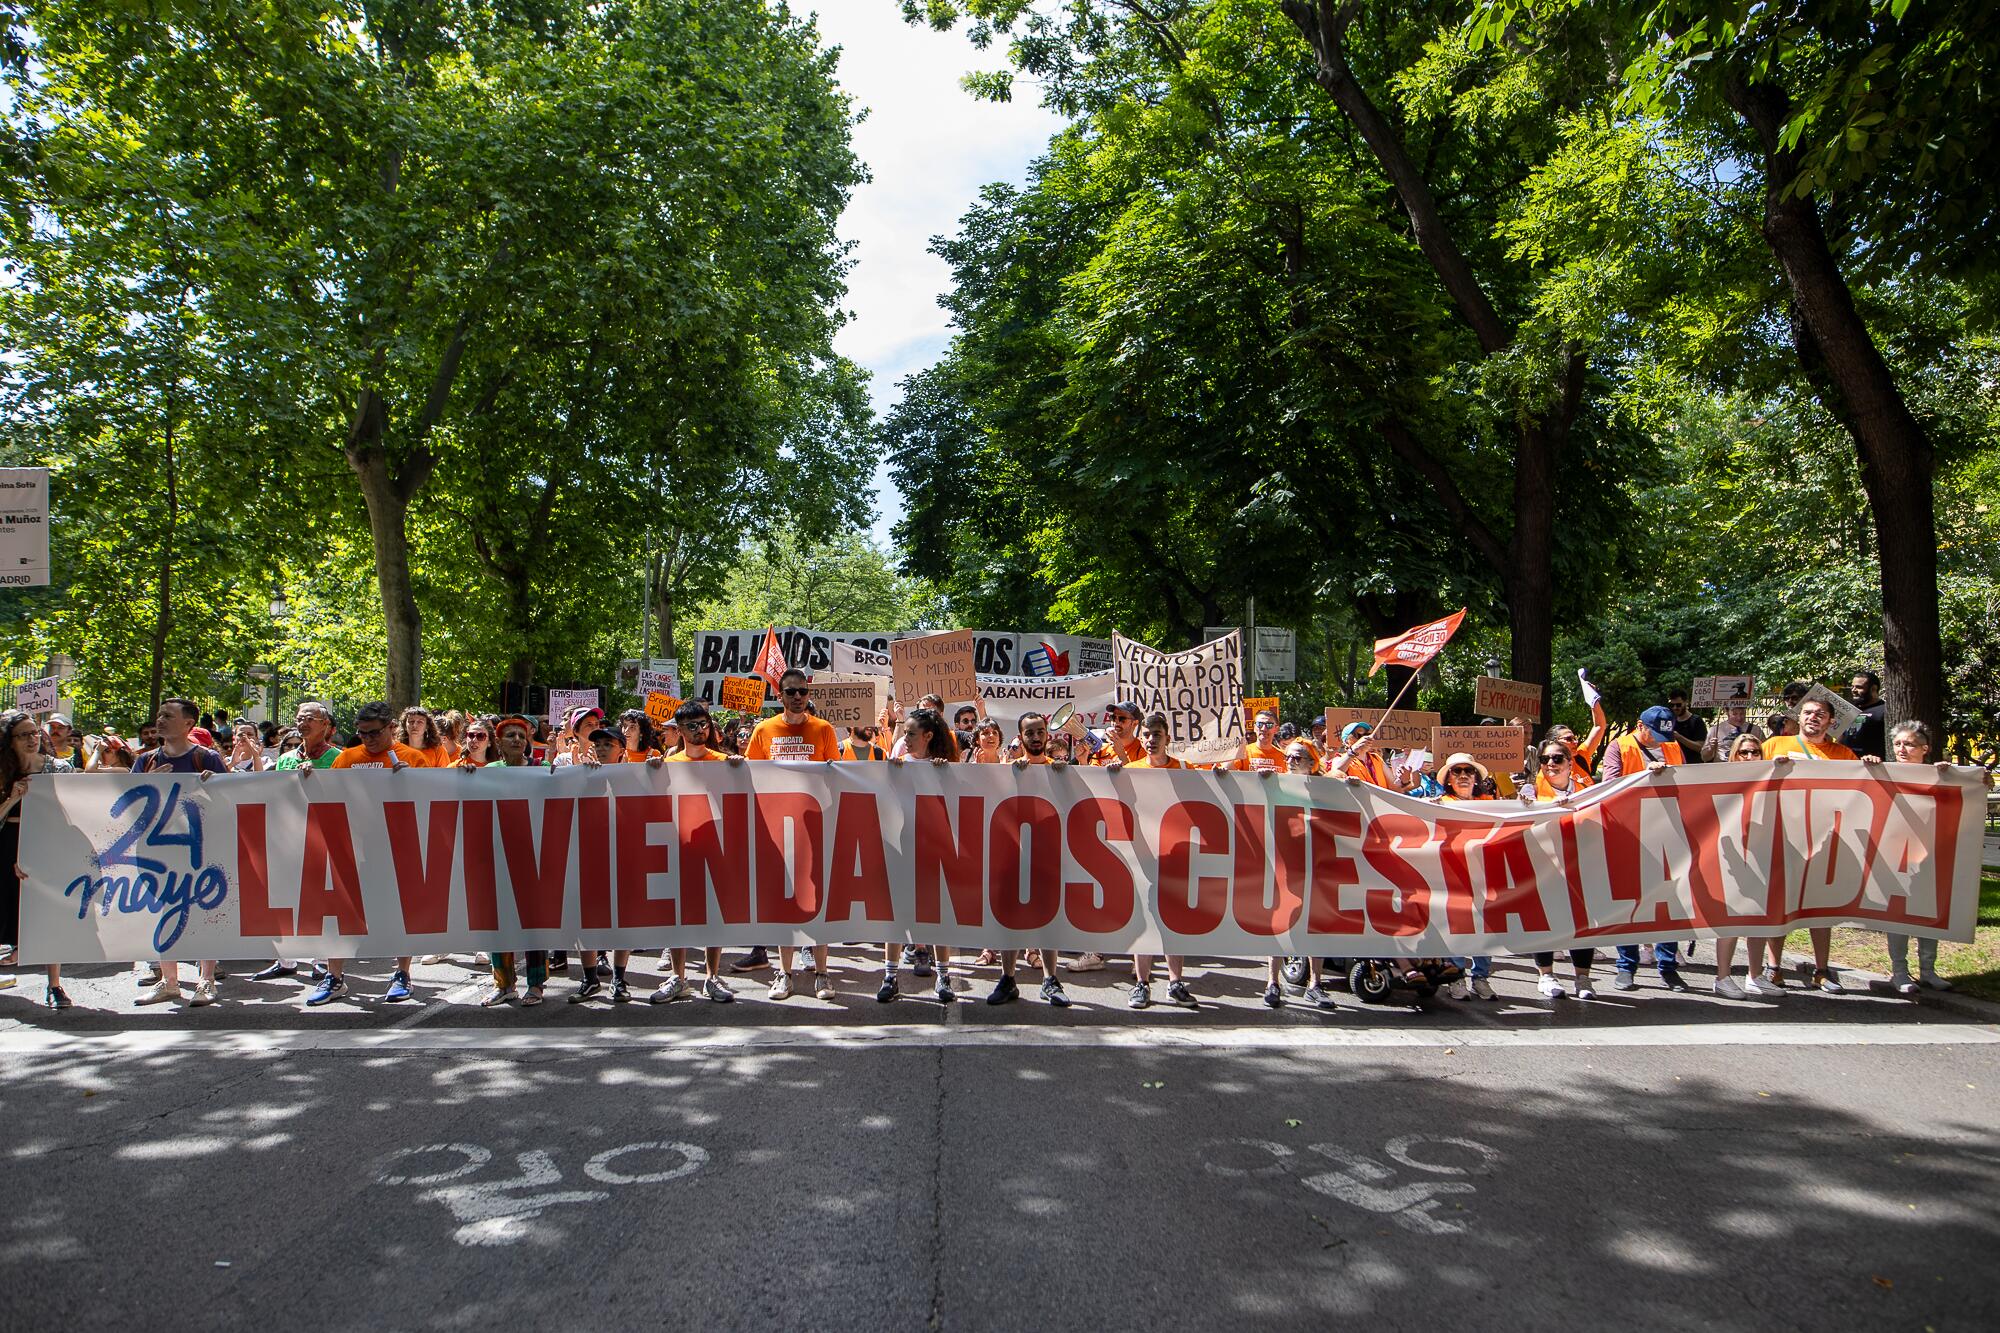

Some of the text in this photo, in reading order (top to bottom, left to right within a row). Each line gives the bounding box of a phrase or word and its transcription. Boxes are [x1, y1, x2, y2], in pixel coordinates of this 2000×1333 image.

[6, 515, 40, 524] Muñoz
[1213, 636, 1239, 662] EN
[908, 659, 965, 676] Y MENOS
[653, 673, 673, 682] CASAS
[19, 679, 53, 694] DERECHO
[828, 687, 873, 699] RENTISTAS
[33, 691, 40, 699] A
[1210, 706, 1244, 738] YA
[771, 736, 803, 744] SINDICATO
[1439, 730, 1458, 738] HAY
[1462, 730, 1482, 739] QUE
[94, 781, 205, 870] 24
[236, 788, 1938, 936] LA VIVIENDA NOS CUESTA LA VIDA
[64, 864, 228, 953] mayo
